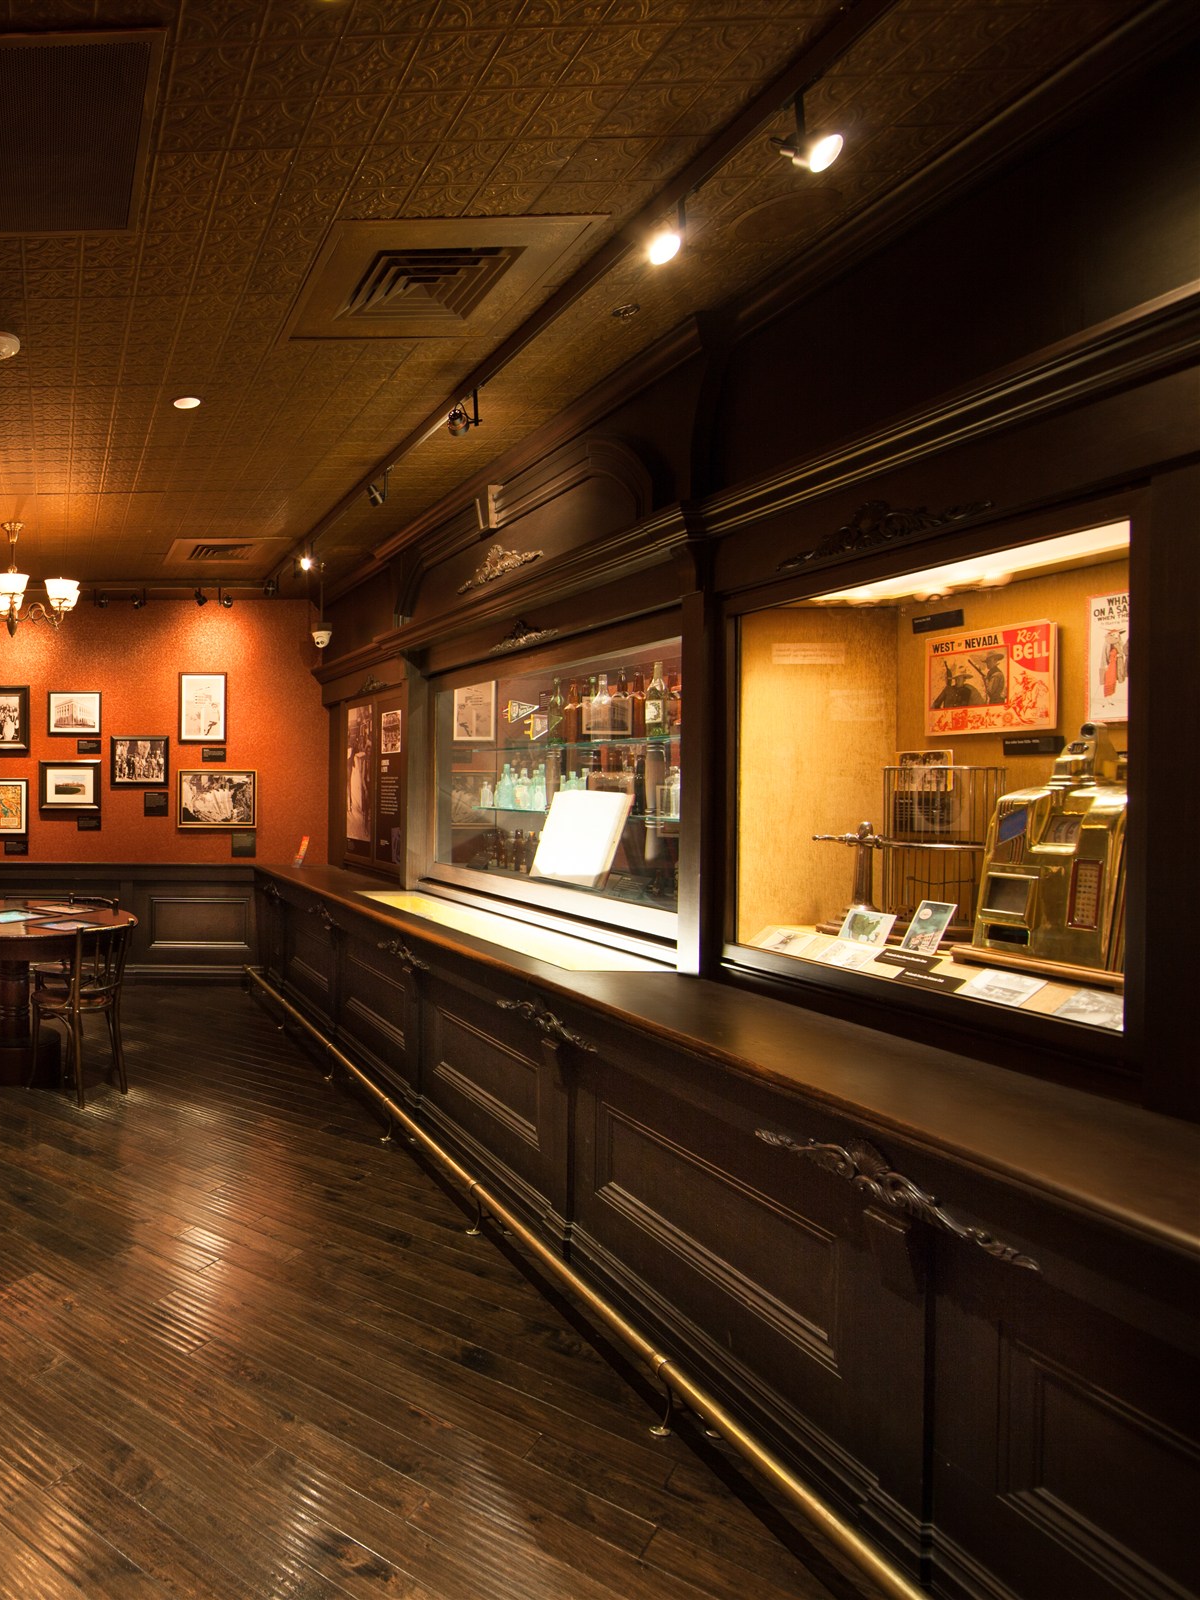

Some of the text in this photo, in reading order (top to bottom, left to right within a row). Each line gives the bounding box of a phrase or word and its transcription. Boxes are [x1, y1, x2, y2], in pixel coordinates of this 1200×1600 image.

[1107, 596, 1130, 606] WHA
[1094, 608, 1105, 617] ON
[1108, 607, 1114, 615] A
[932, 642, 955, 653] WEST
[965, 635, 999, 649] NEVADA
